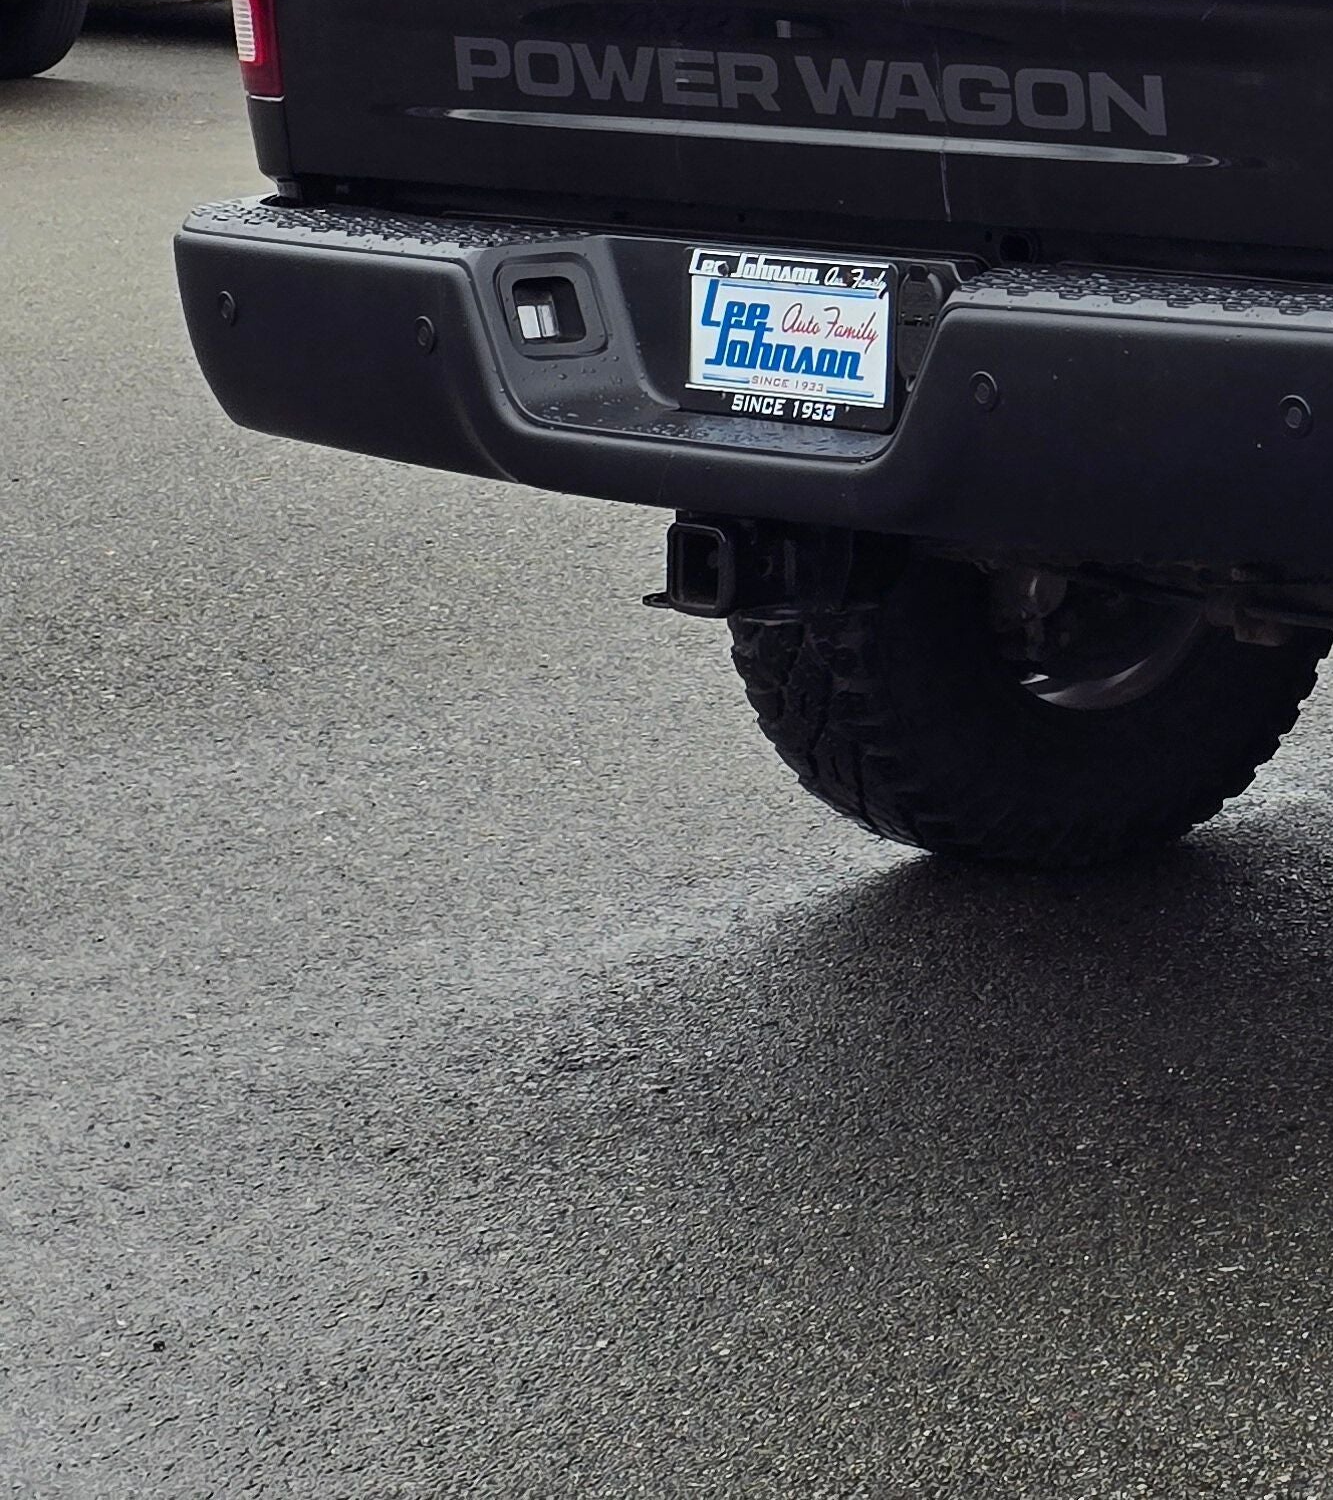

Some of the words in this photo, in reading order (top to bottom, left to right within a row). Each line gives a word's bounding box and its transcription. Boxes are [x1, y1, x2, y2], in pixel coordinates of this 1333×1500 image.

[453, 35, 782, 112] POWER
[794, 55, 1169, 137] WAGON
[731, 252, 820, 285] Johnson
[701, 279, 774, 332] Lee
[781, 302, 821, 336] Auto
[823, 306, 879, 355] Family
[704, 321, 864, 381] Johnson
[731, 393, 787, 416] SINCE
[792, 400, 836, 422] 1933
[752, 375, 789, 389] SINCE
[794, 380, 825, 393] 1933
